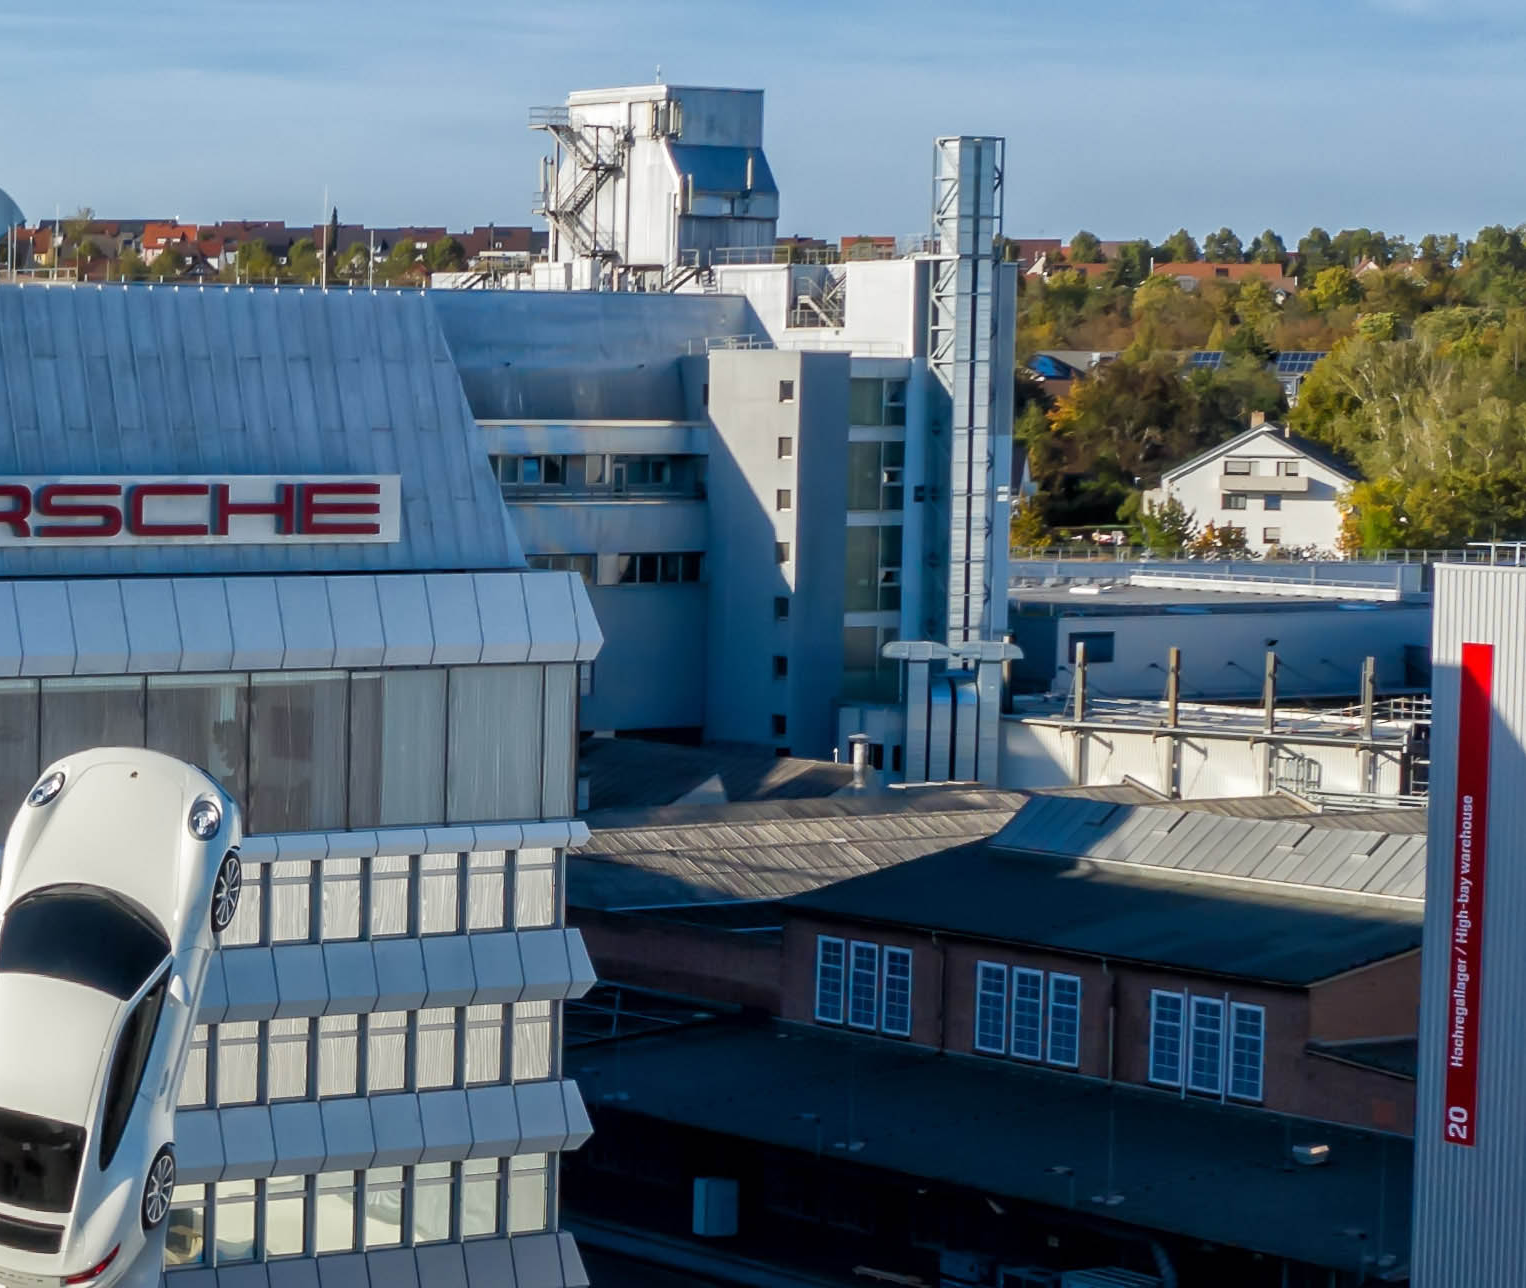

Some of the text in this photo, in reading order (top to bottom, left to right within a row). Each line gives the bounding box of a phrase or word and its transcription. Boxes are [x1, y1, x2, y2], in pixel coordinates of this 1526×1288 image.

[1459, 795, 1473, 875] warehouse
[1455, 877, 1473, 944] High-bay
[1451, 958, 1470, 1068] Hochregallager
[1448, 1106, 1468, 1139] 20
